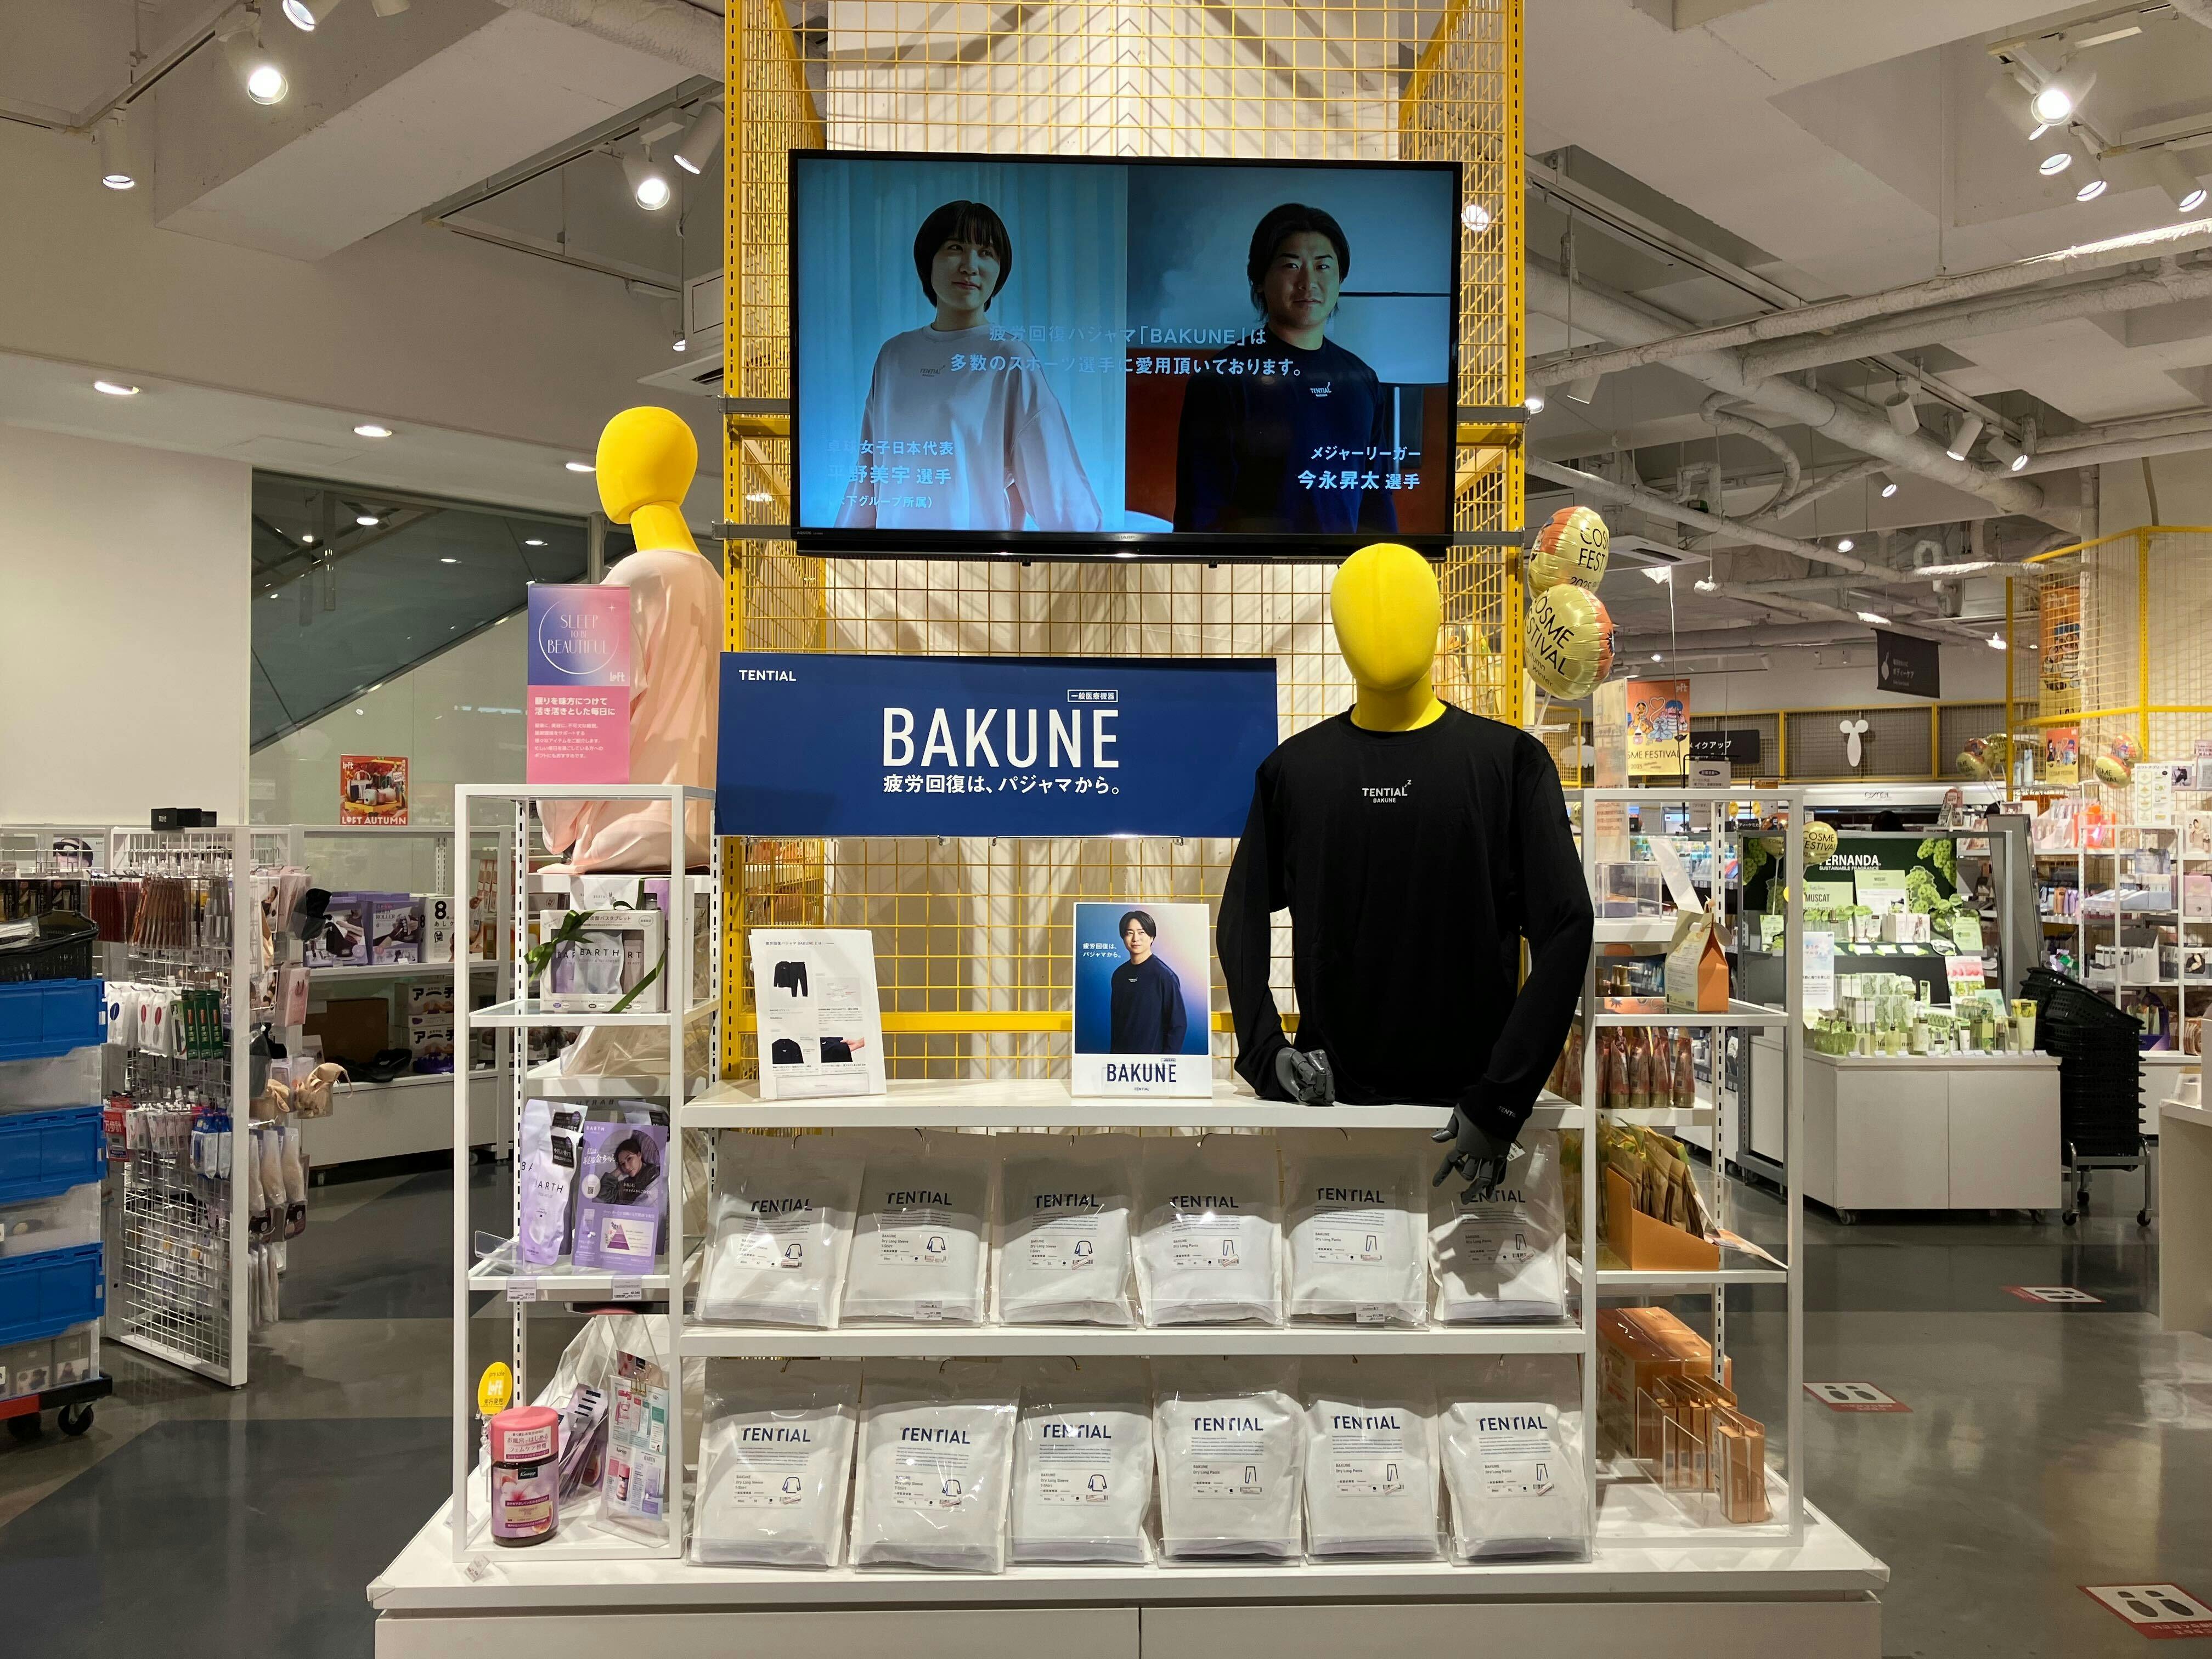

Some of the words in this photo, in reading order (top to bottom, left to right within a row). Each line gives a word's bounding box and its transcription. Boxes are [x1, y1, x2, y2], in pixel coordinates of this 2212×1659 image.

[1311, 446, 1421, 462] メジャーリーガー
[916, 468, 952, 485] 選手
[1297, 470, 1380, 490] 今永昇太
[1385, 473, 1420, 490] 選手
[560, 614, 599, 629] SLEEP
[1534, 589, 1575, 650] OSME
[571, 630, 579, 639] TO
[1523, 607, 1566, 676] ESTIVAL
[547, 639, 610, 654] BEAUTIFUL
[738, 669, 797, 682] TENTIAL
[534, 697, 608, 706] 眠りを味方につけて
[1070, 691, 1115, 701] 一般医療機器
[534, 707, 616, 716] 活き活きとした毎日に
[883, 707, 1120, 769] BAKUNE
[1644, 749, 1681, 759] FESTIVAL
[883, 774, 1120, 795] 疲労回復は、パジャマから。
[1362, 787, 1408, 798] TENTIAL
[364, 816, 406, 825] AUTUMN
[1803, 830, 1835, 843] COSME
[1805, 894, 1830, 902] MUSCAT
[580, 949, 620, 957] BARTH
[1107, 1063, 1177, 1082] BAKUNE
[886, 1190, 952, 1206] TENTIAL
[1034, 1193, 1099, 1208] TENTIAL
[1169, 1195, 1239, 1209] TENTIAL
[1317, 1187, 1385, 1204] TENTIAL
[750, 1198, 813, 1212] TENTIAL
[1191, 1417, 1264, 1431] TENTIAL
[1330, 1415, 1401, 1430] TENTIAL
[1476, 1416, 1548, 1431] TENTIAL
[741, 1427, 811, 1442] TENTIAL
[900, 1427, 970, 1444] TENTIAL
[1041, 1424, 1111, 1439] TENTIAL
